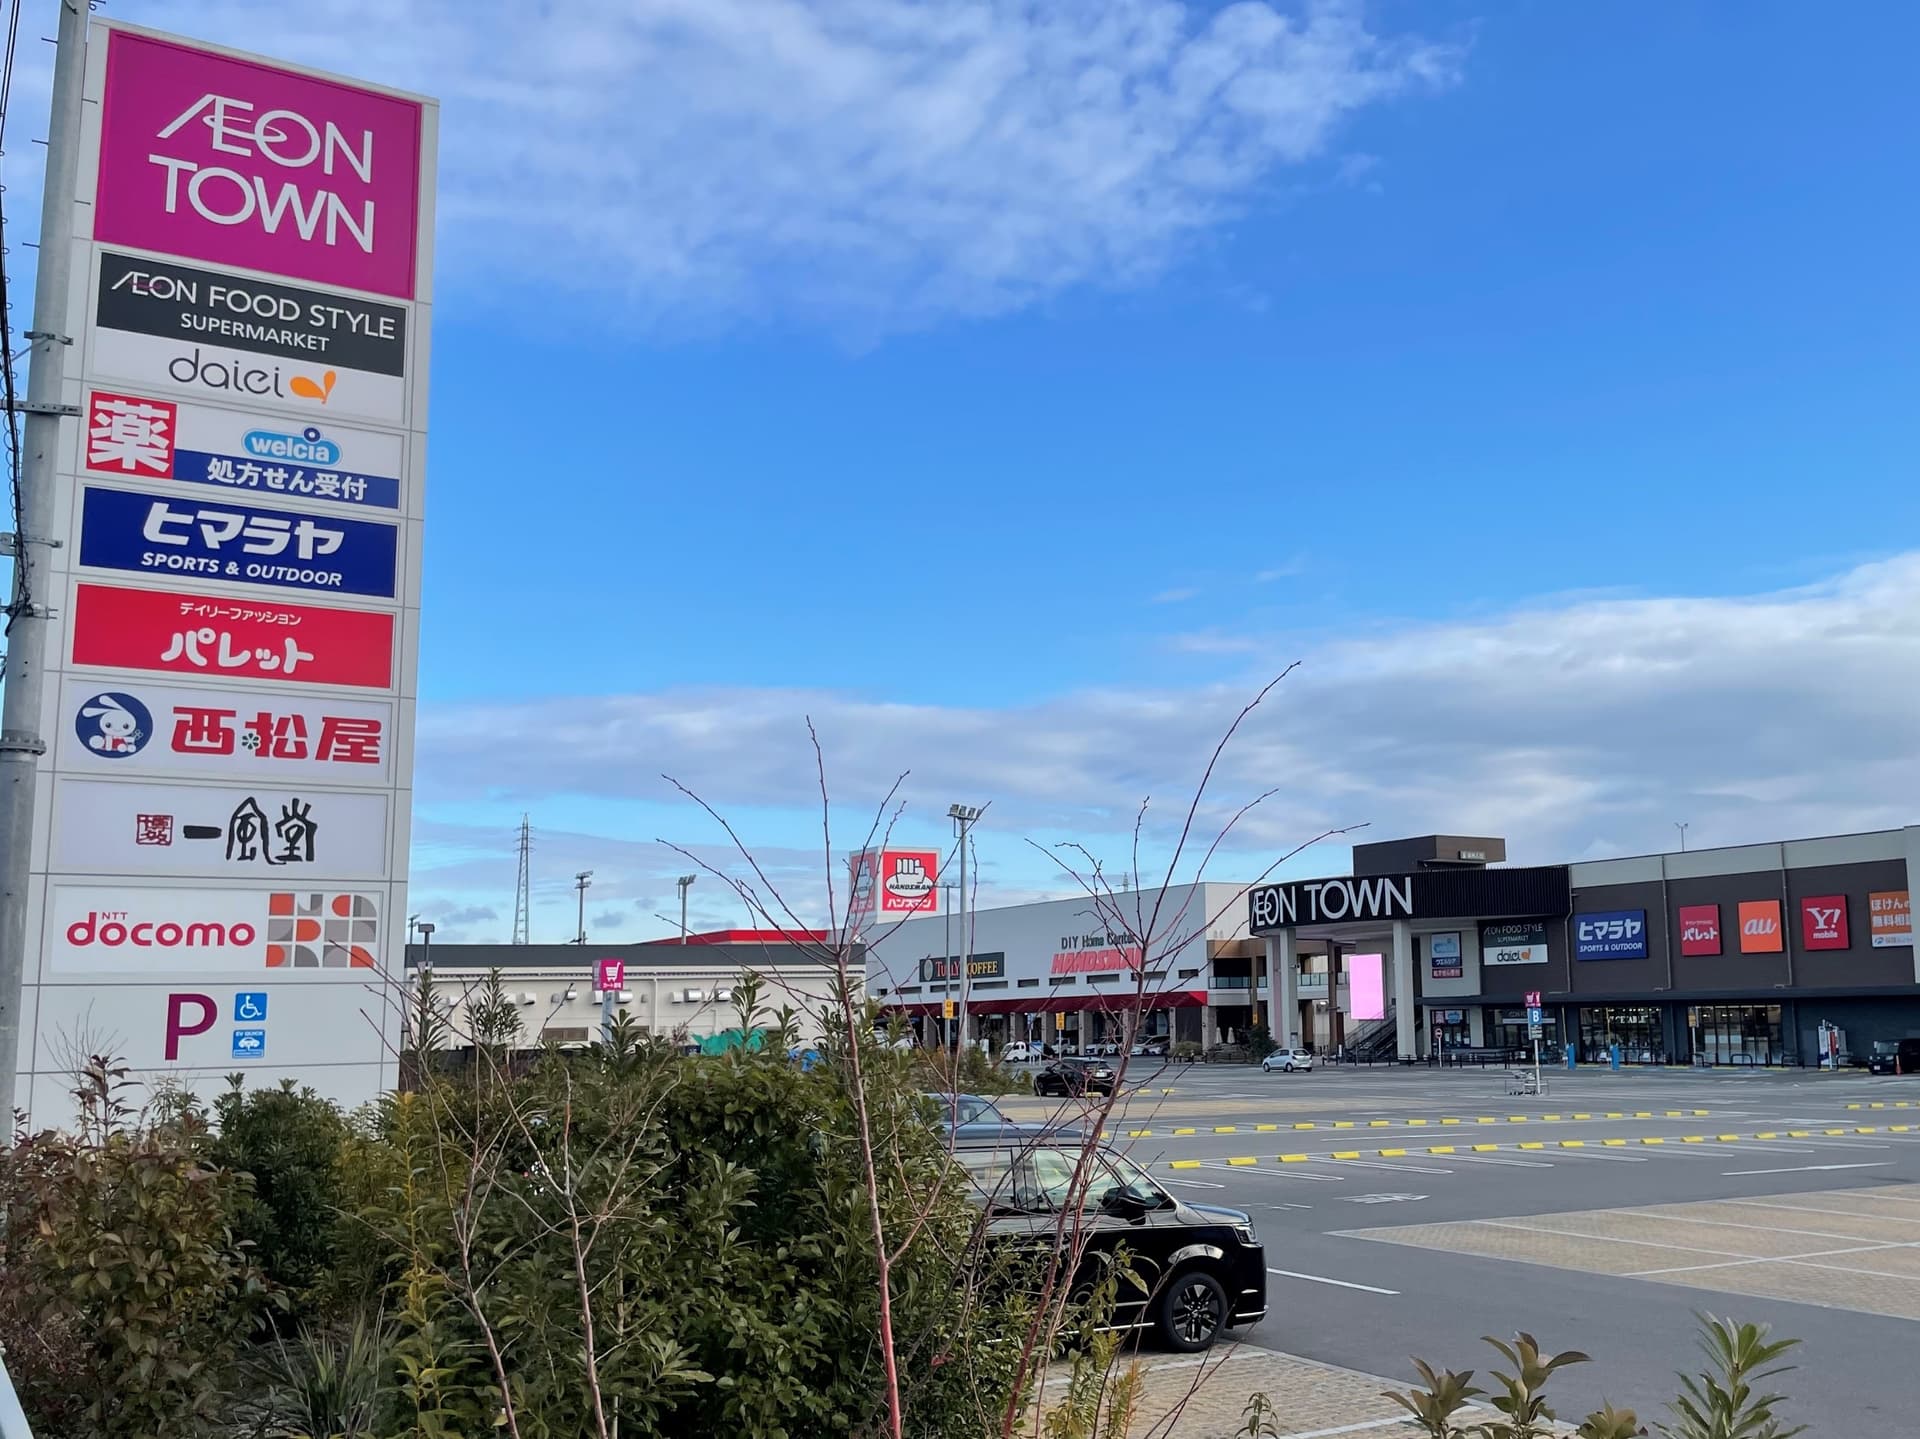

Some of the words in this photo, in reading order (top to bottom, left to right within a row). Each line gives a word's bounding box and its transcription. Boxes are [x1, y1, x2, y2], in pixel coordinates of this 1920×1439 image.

[149, 154, 374, 253] TOWN
[209, 286, 300, 321] FOOD
[310, 304, 395, 340] STYLE
[181, 313, 329, 352] SUPERMARKET
[168, 349, 284, 398] daiei
[89, 400, 170, 473] 薬
[251, 428, 330, 462] welcia
[207, 457, 367, 501] 処方せん受付
[143, 502, 345, 560] ヒマラヤ
[142, 553, 219, 573] SPORTS
[226, 562, 239, 576] &
[246, 564, 342, 586] OUTDOOR
[180, 602, 301, 625] デイリーファッション
[161, 628, 314, 674] パレット
[171, 706, 382, 764] 西松屋
[183, 796, 317, 865] 一風堂
[102, 912, 128, 920] NTT
[1304, 877, 1413, 921] TOWN
[66, 912, 255, 947] docomo
[1502, 924, 1521, 934] FOOD
[1523, 922, 1543, 932] STYLE
[1579, 919, 1641, 941] ヒマラヤ
[1682, 927, 1718, 941] パレット
[1744, 918, 1777, 935] au
[1806, 907, 1841, 930] Y!
[1813, 931, 1838, 939] mobile
[1061, 936, 1079, 949] DIY
[1497, 949, 1521, 962] daiei
[1580, 943, 1603, 952] SPORTS
[1611, 942, 1642, 951] OUTDOOR
[165, 993, 218, 1061] P
